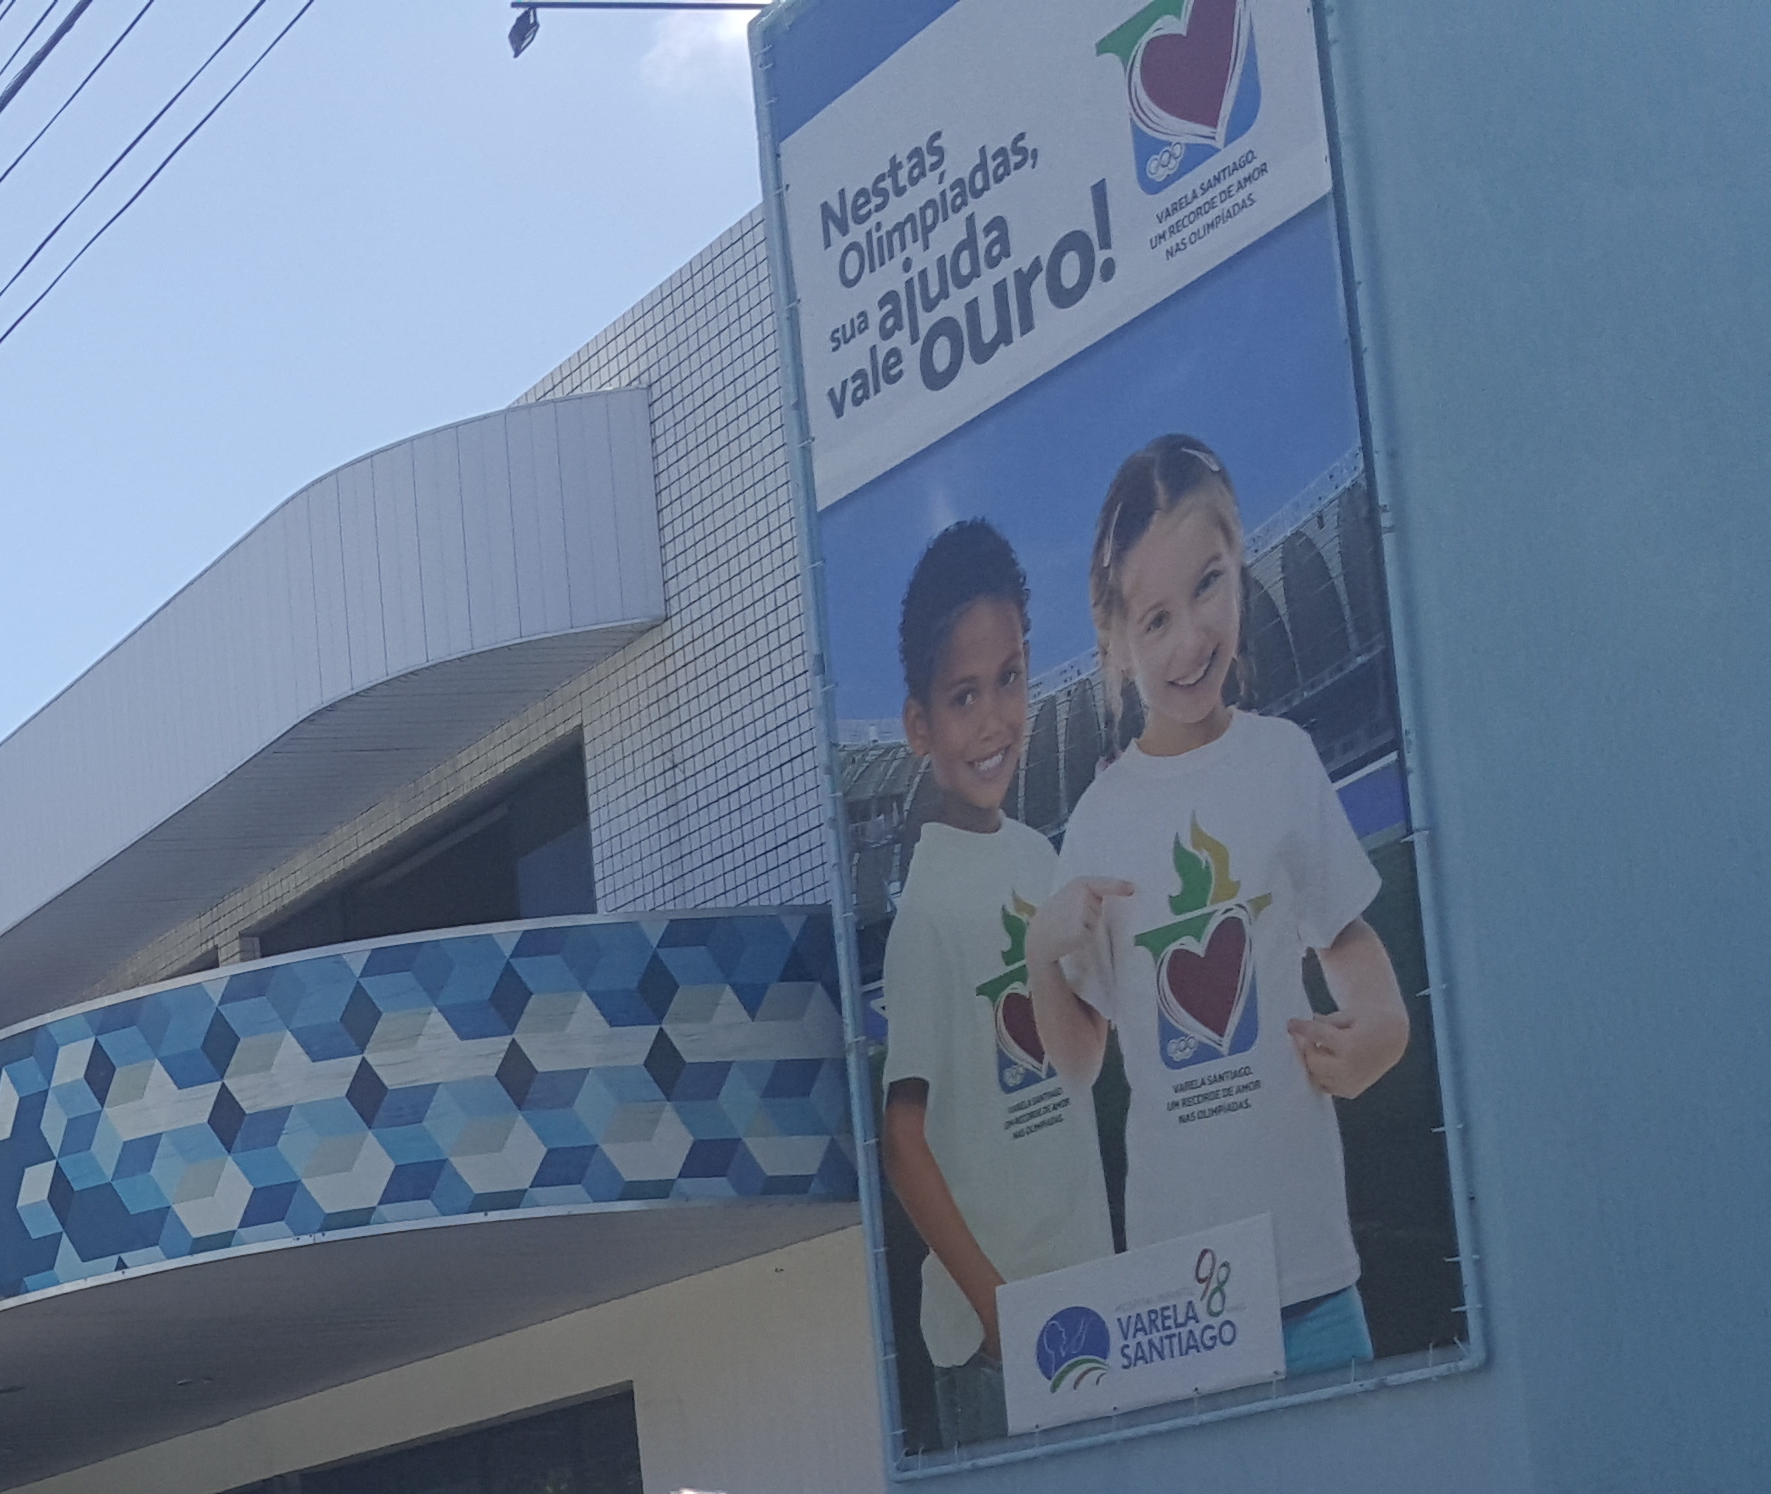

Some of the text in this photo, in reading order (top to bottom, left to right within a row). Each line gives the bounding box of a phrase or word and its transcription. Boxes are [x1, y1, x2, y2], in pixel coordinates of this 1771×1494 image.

[820, 129, 946, 250] Nestas
[838, 132, 1039, 289] Olimpíadas,
[1149, 162, 1269, 250] UM RECORDE DE AMOR
[1155, 189, 1199, 224] VARELA
[829, 212, 1011, 352] sua ajuda
[1165, 238, 1187, 260] NAS
[826, 178, 1116, 419] vale ouro!
[1117, 1301, 1200, 1341] VARELA
[1120, 1320, 1236, 1369] SANTIAGO
